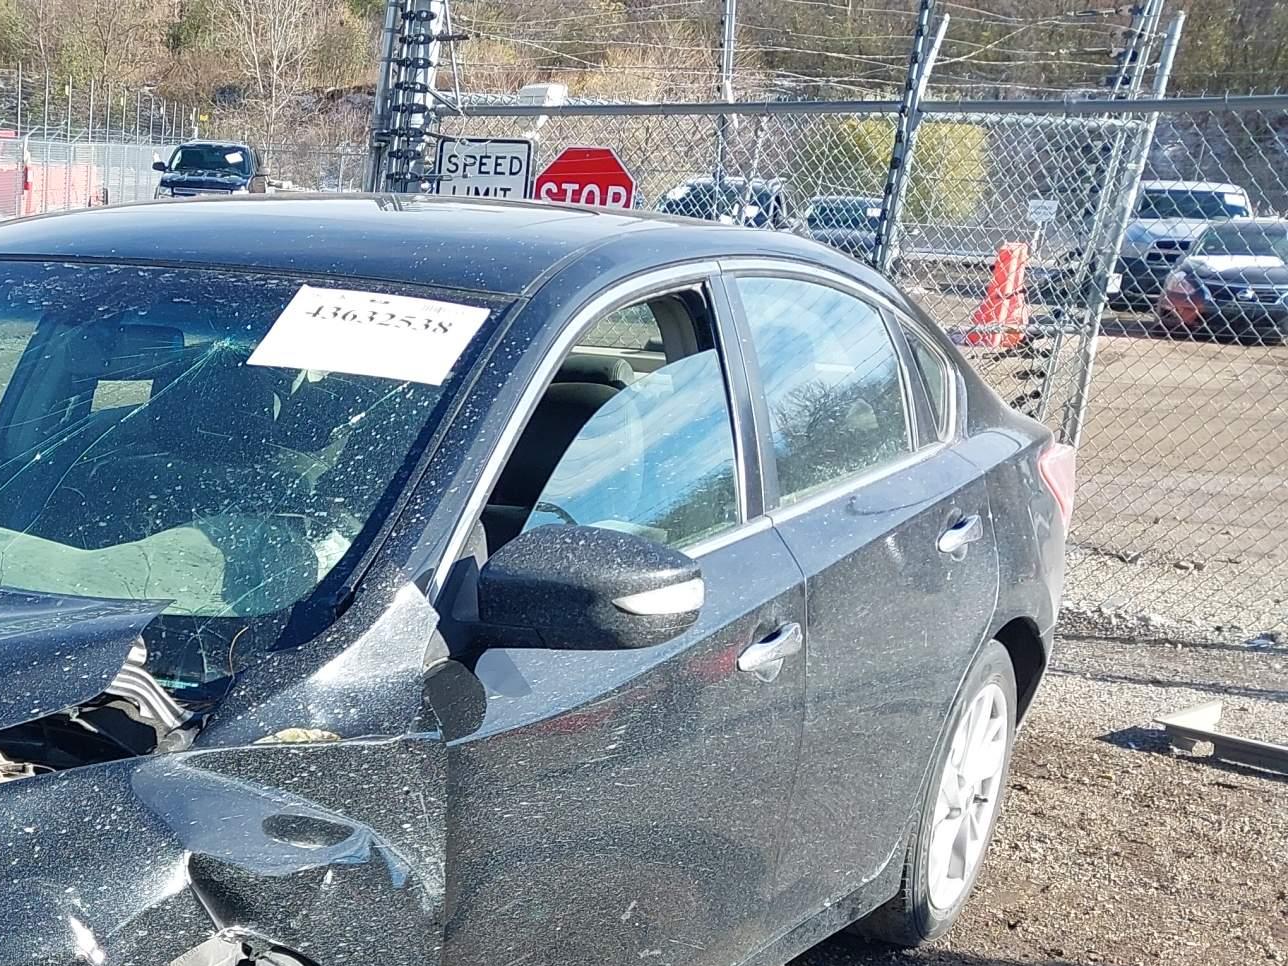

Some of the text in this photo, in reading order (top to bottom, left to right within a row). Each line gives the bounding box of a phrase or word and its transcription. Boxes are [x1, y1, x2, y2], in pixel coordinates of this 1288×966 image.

[446, 154, 523, 176] SPEED
[540, 182, 627, 209] STOP
[305, 305, 453, 334] 43632538
